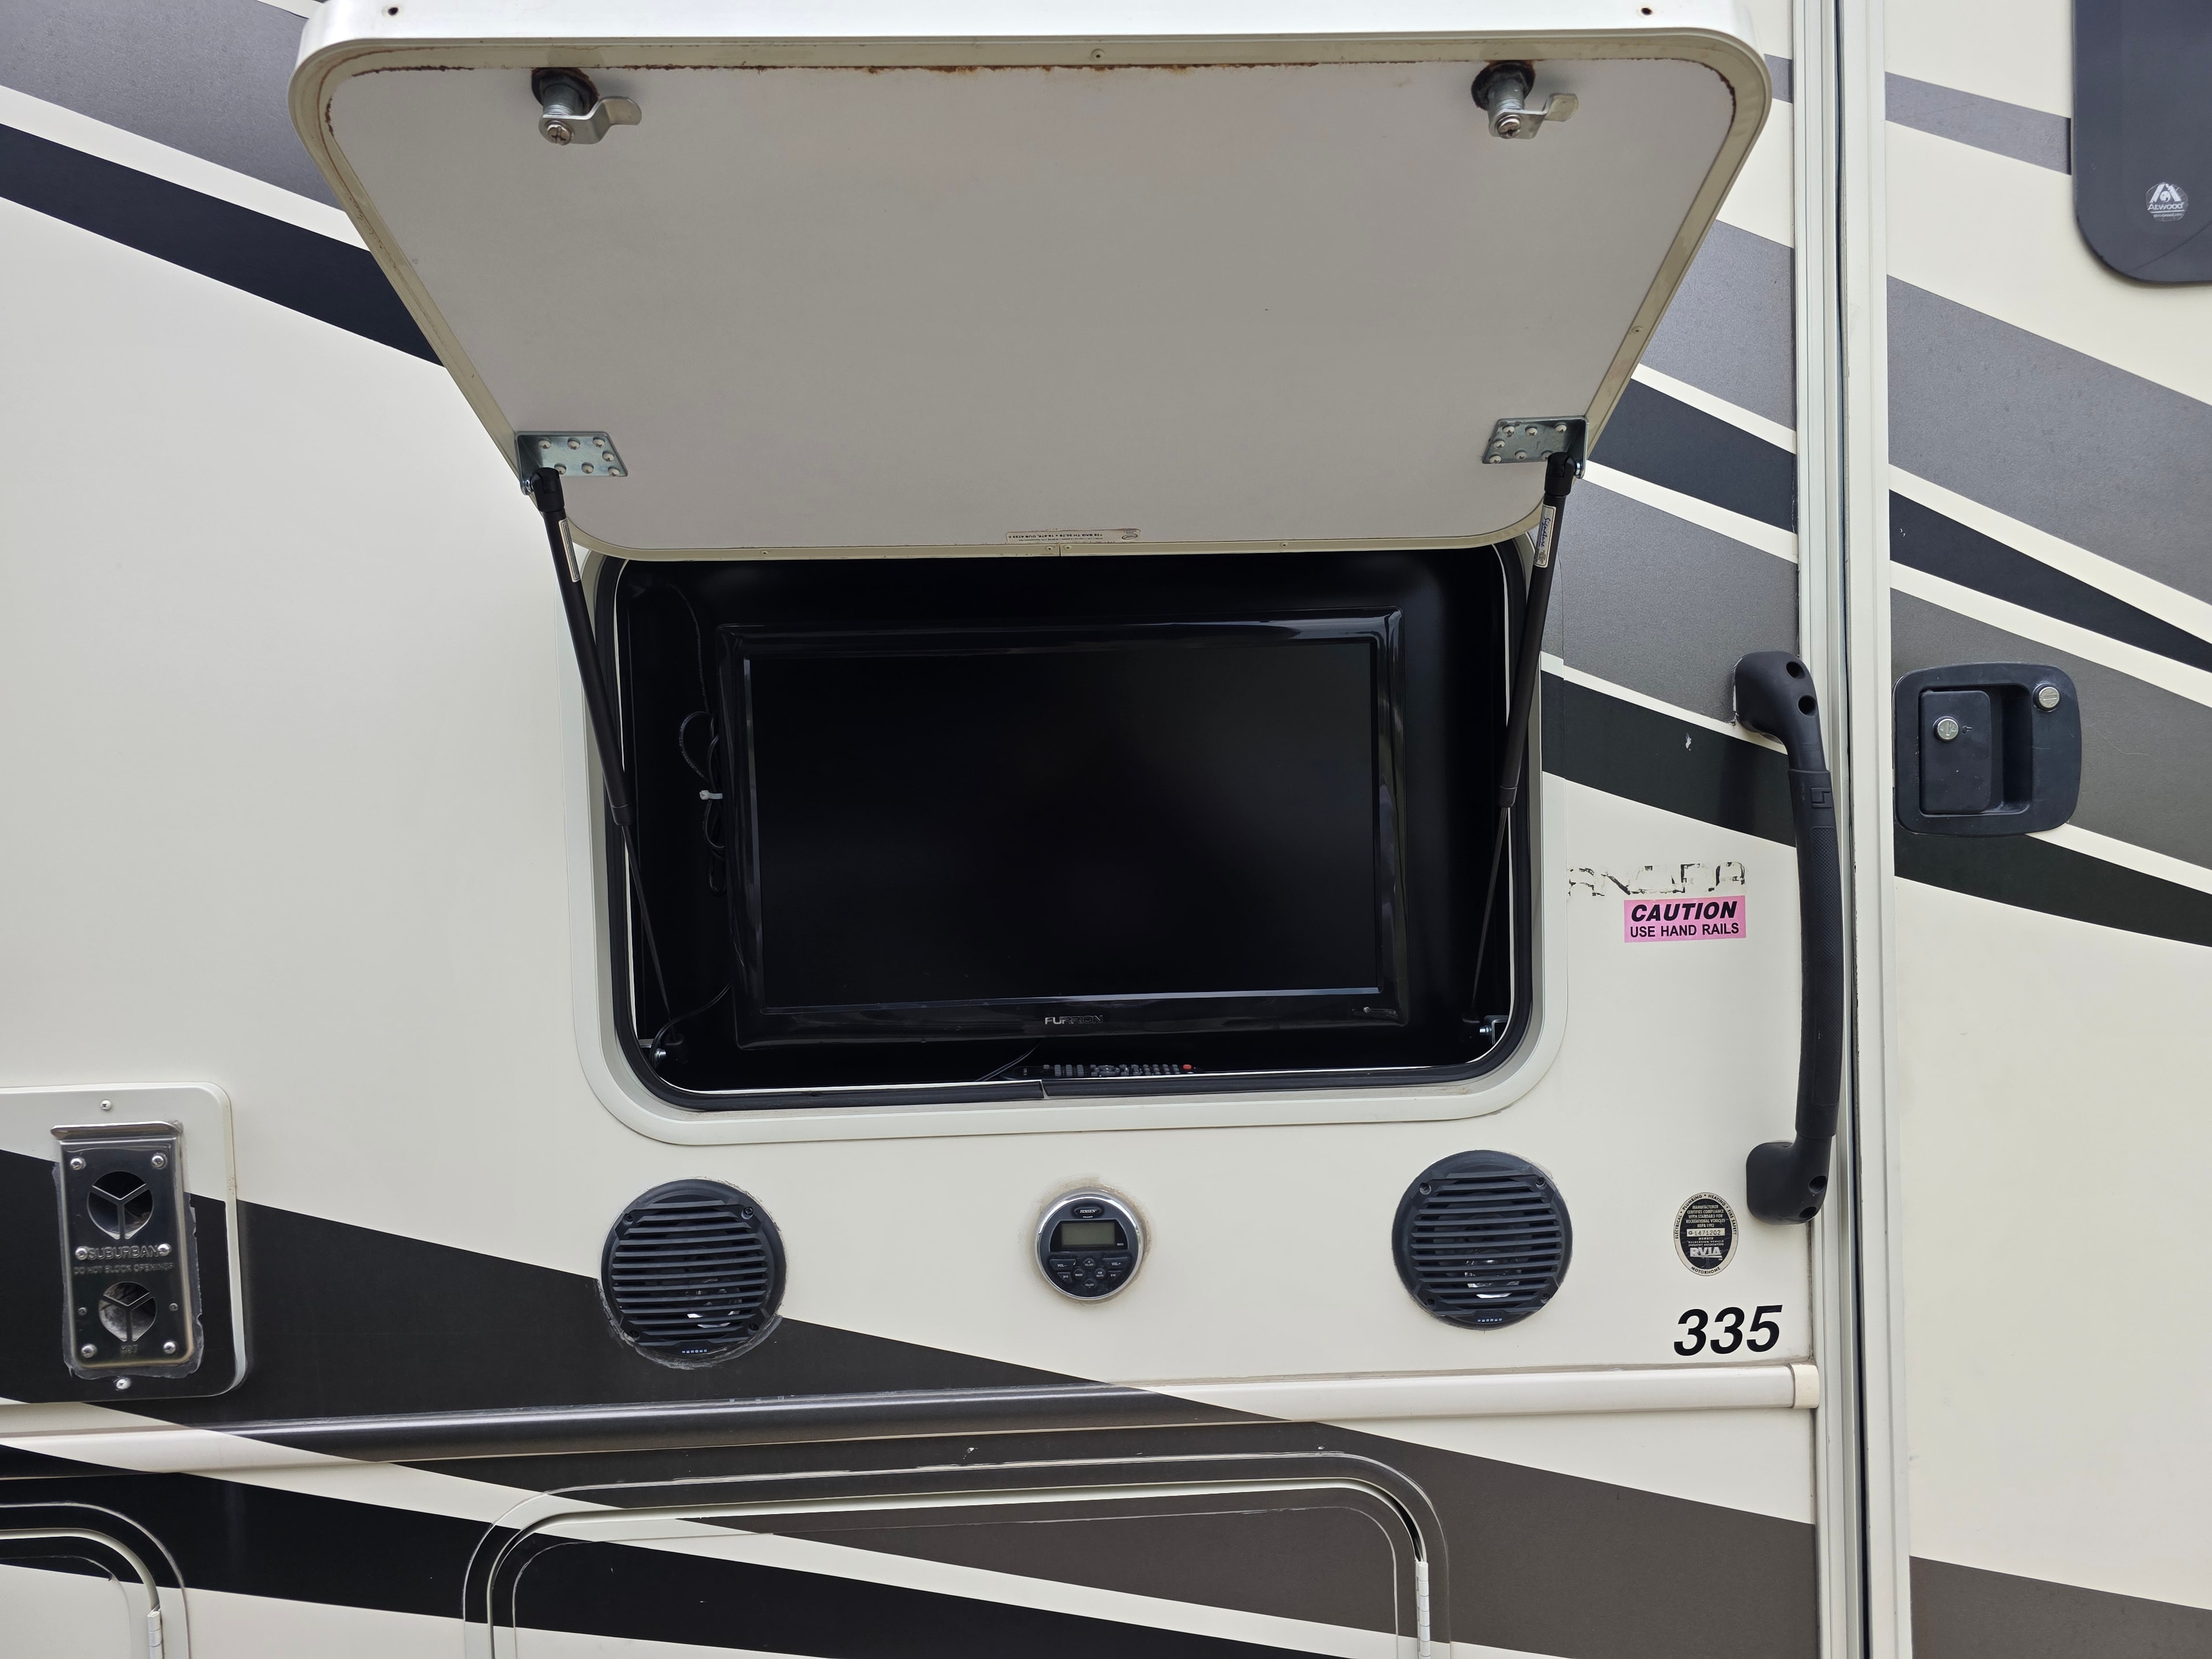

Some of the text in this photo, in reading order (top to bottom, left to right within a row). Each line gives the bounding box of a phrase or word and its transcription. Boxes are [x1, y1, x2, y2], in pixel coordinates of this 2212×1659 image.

[2147, 202, 2184, 211] Atwood
[1540, 517, 1551, 547] Signature
[1631, 901, 1737, 922] CAUTION
[1630, 922, 1739, 938] USE HAND RAILS
[1044, 1015, 1103, 1025] FURRION
[1682, 1195, 1702, 1210] PLUMBING
[1708, 1194, 1726, 1206] HEATING
[87, 1245, 159, 1260] SUBURBAN
[1690, 1247, 1722, 1257] RVIA
[73, 1267, 86, 1275] DO
[105, 1264, 131, 1274] BLOCK
[1691, 1266, 1721, 1274] MOTORHOME
[1673, 1304, 1783, 1356] 335
